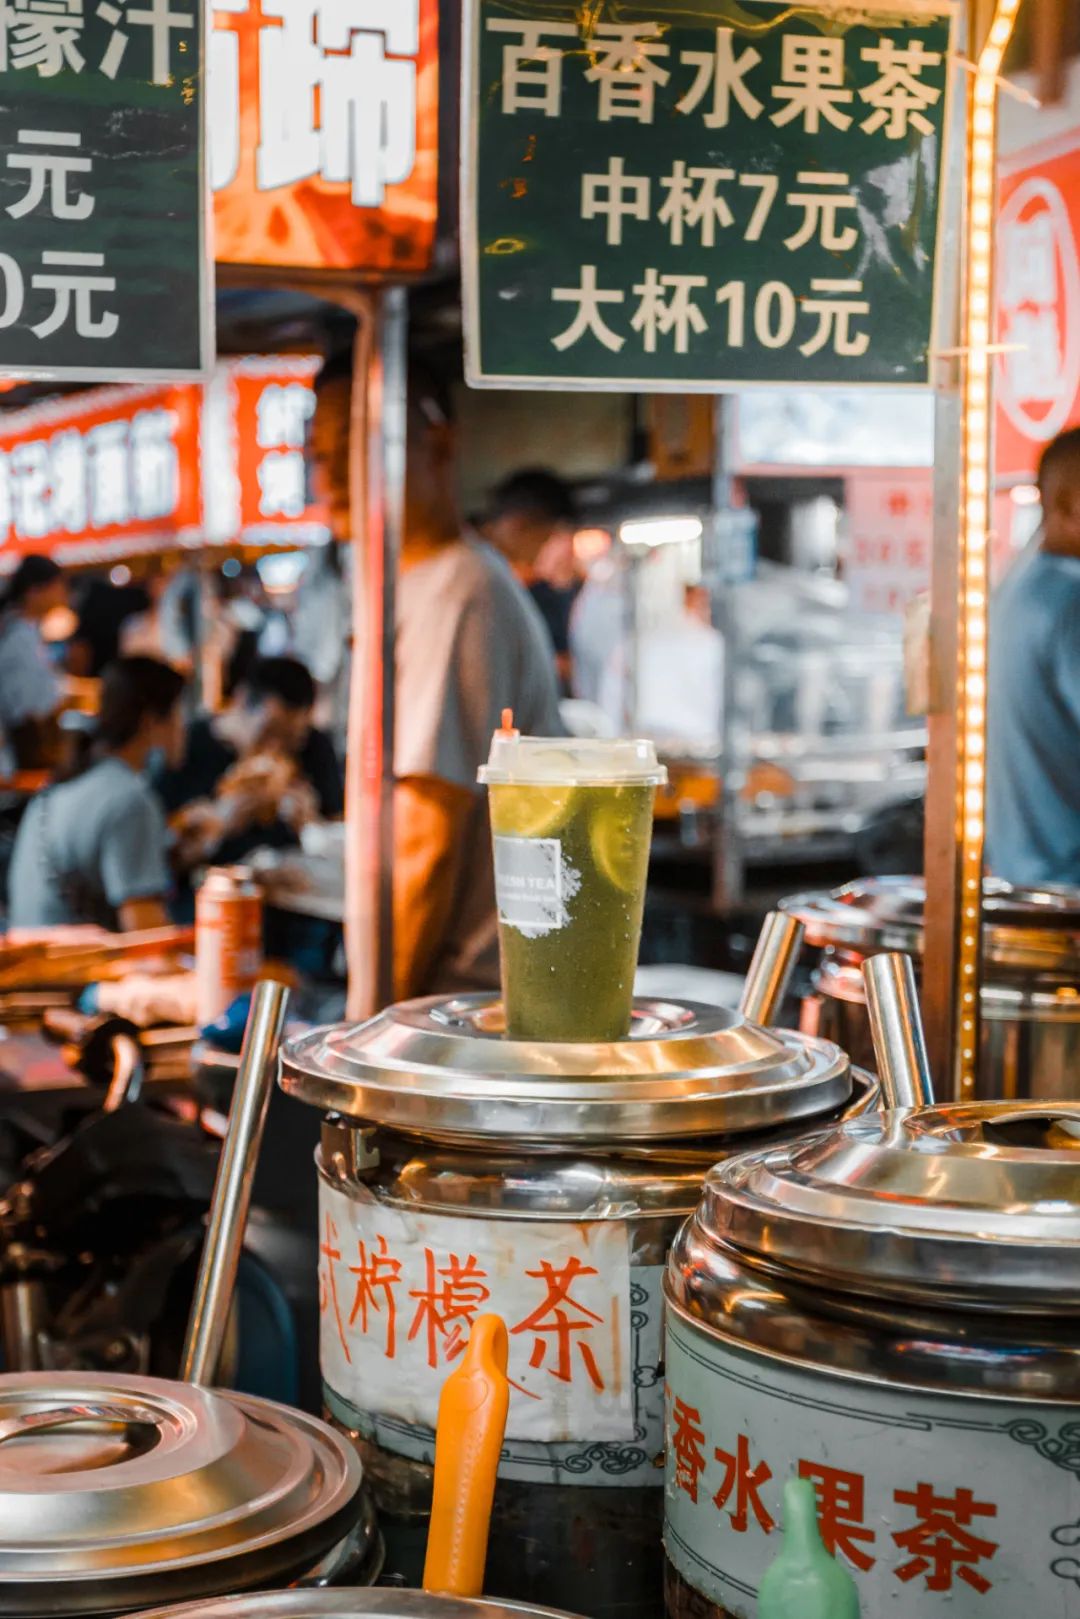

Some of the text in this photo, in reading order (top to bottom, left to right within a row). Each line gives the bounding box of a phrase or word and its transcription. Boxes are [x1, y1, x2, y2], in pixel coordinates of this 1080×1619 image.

[486, 17, 943, 140] 百香水果茶
[580, 156, 859, 252] 中杯7元
[551, 264, 871, 359] 大杯10元
[664, 1383, 1000, 1595] 香水果茶
